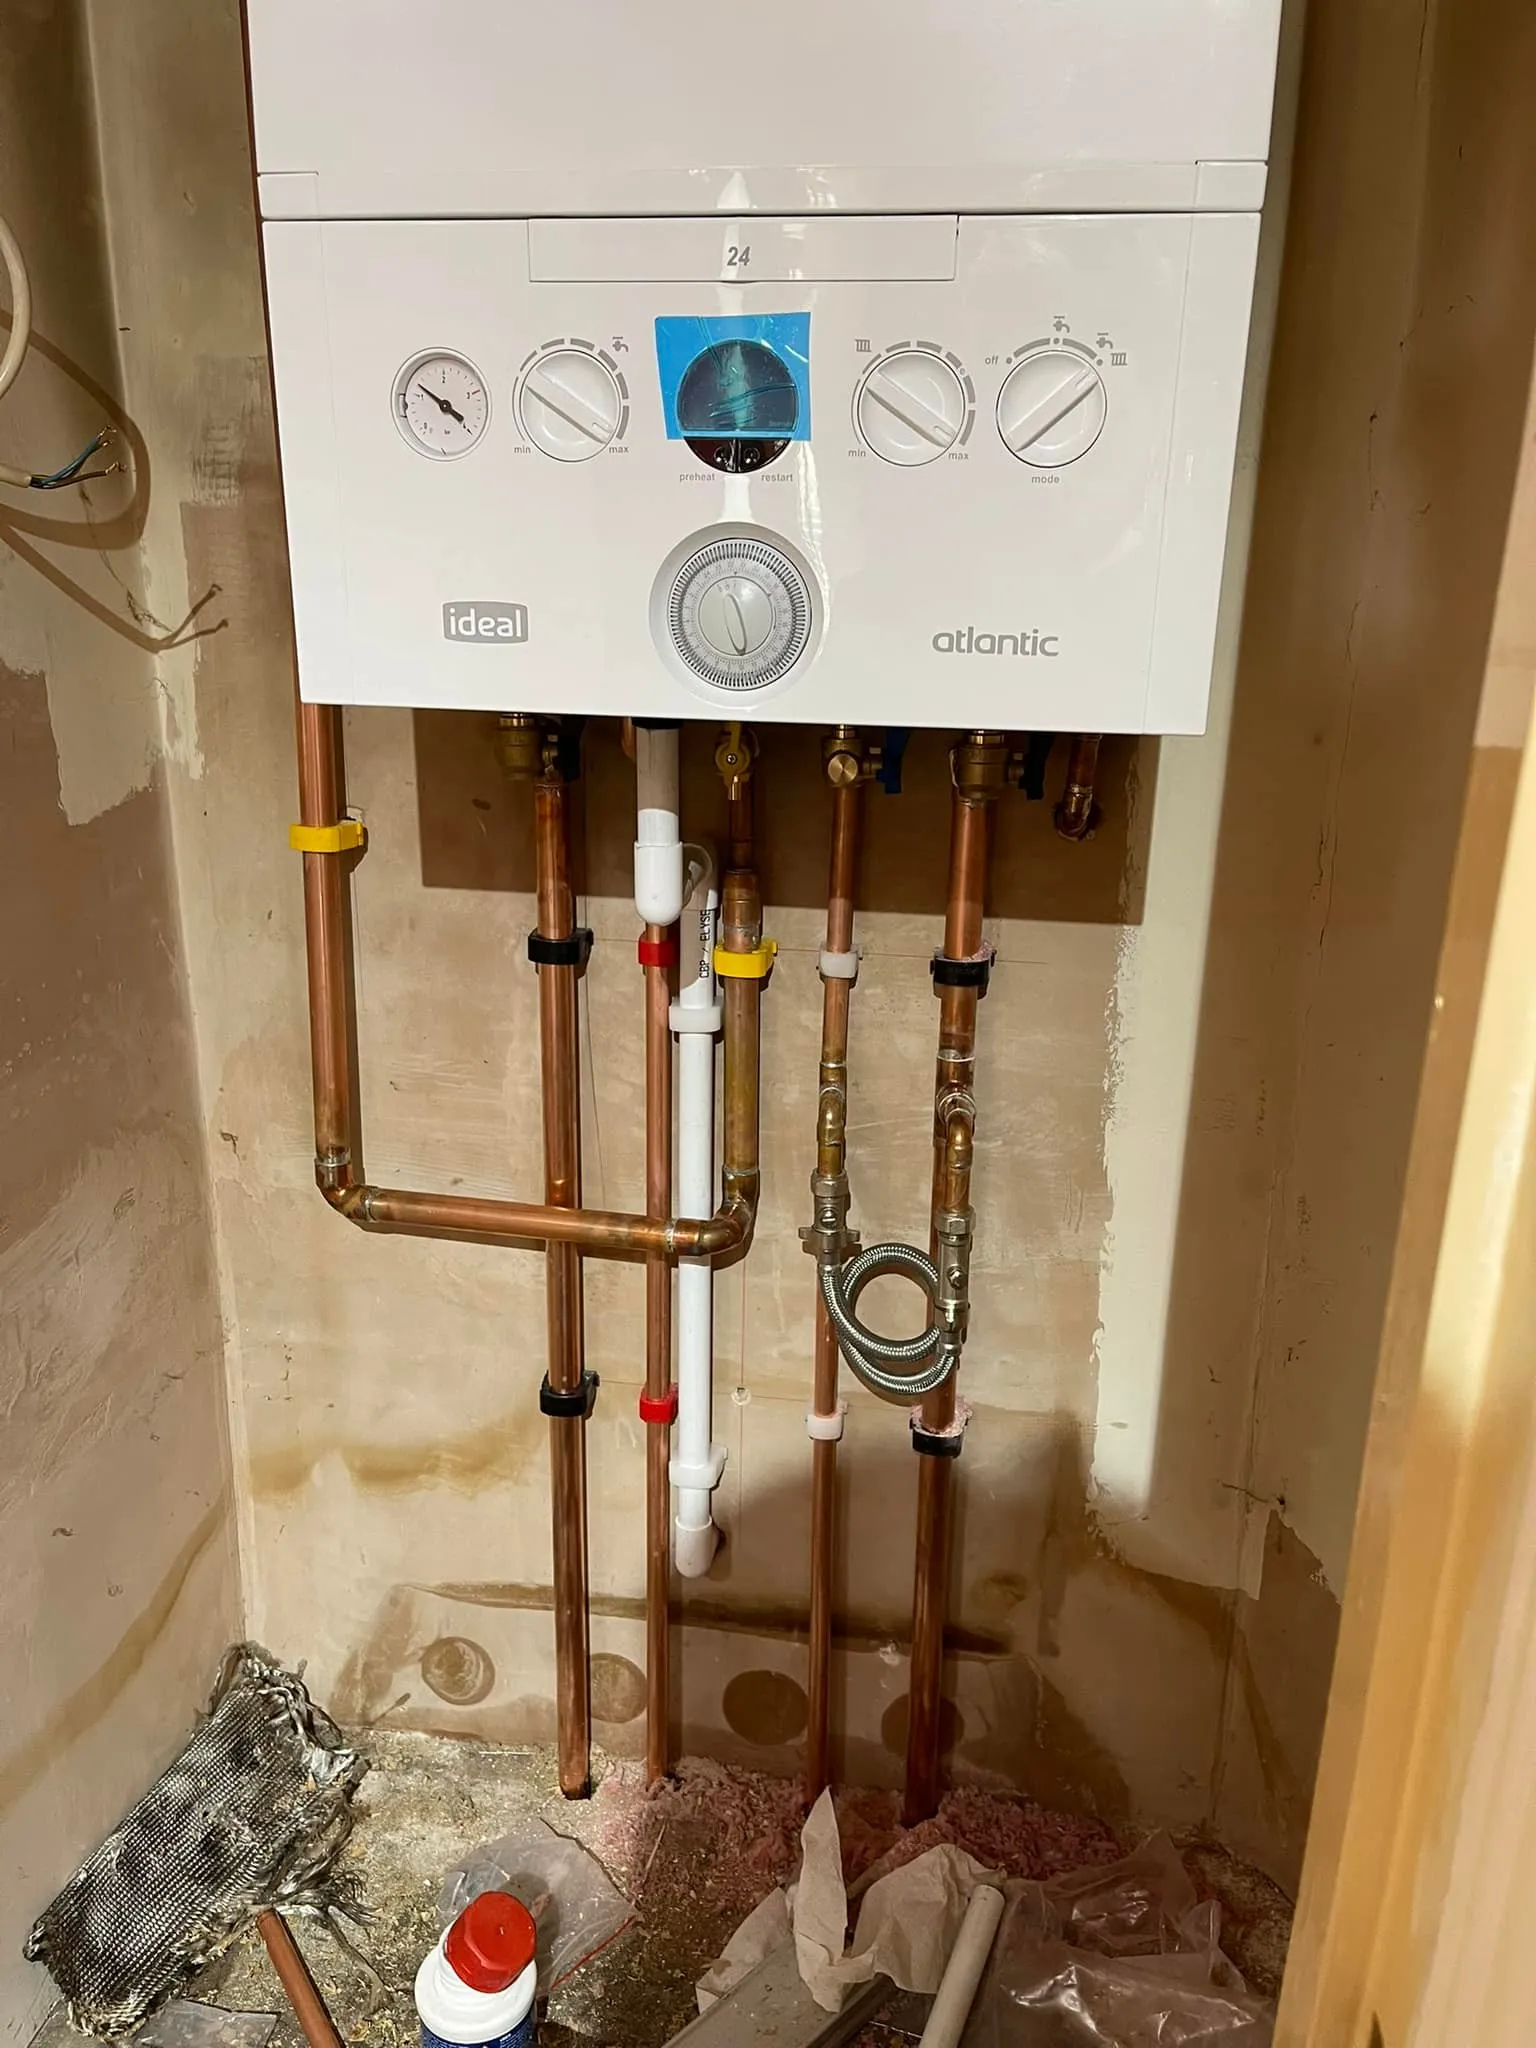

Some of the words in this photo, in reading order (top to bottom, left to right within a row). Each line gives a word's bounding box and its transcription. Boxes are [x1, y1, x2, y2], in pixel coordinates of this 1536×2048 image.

[727, 247, 750, 266] 24
[984, 355, 999, 365] off
[513, 445, 531, 453] min
[608, 446, 629, 454] max
[848, 449, 866, 457] min
[948, 452, 969, 460] max
[679, 473, 715, 483] preheat
[761, 473, 793, 482] restart
[1031, 474, 1060, 484] mode
[449, 607, 522, 637] ideal
[932, 626, 1059, 657] atlantic
